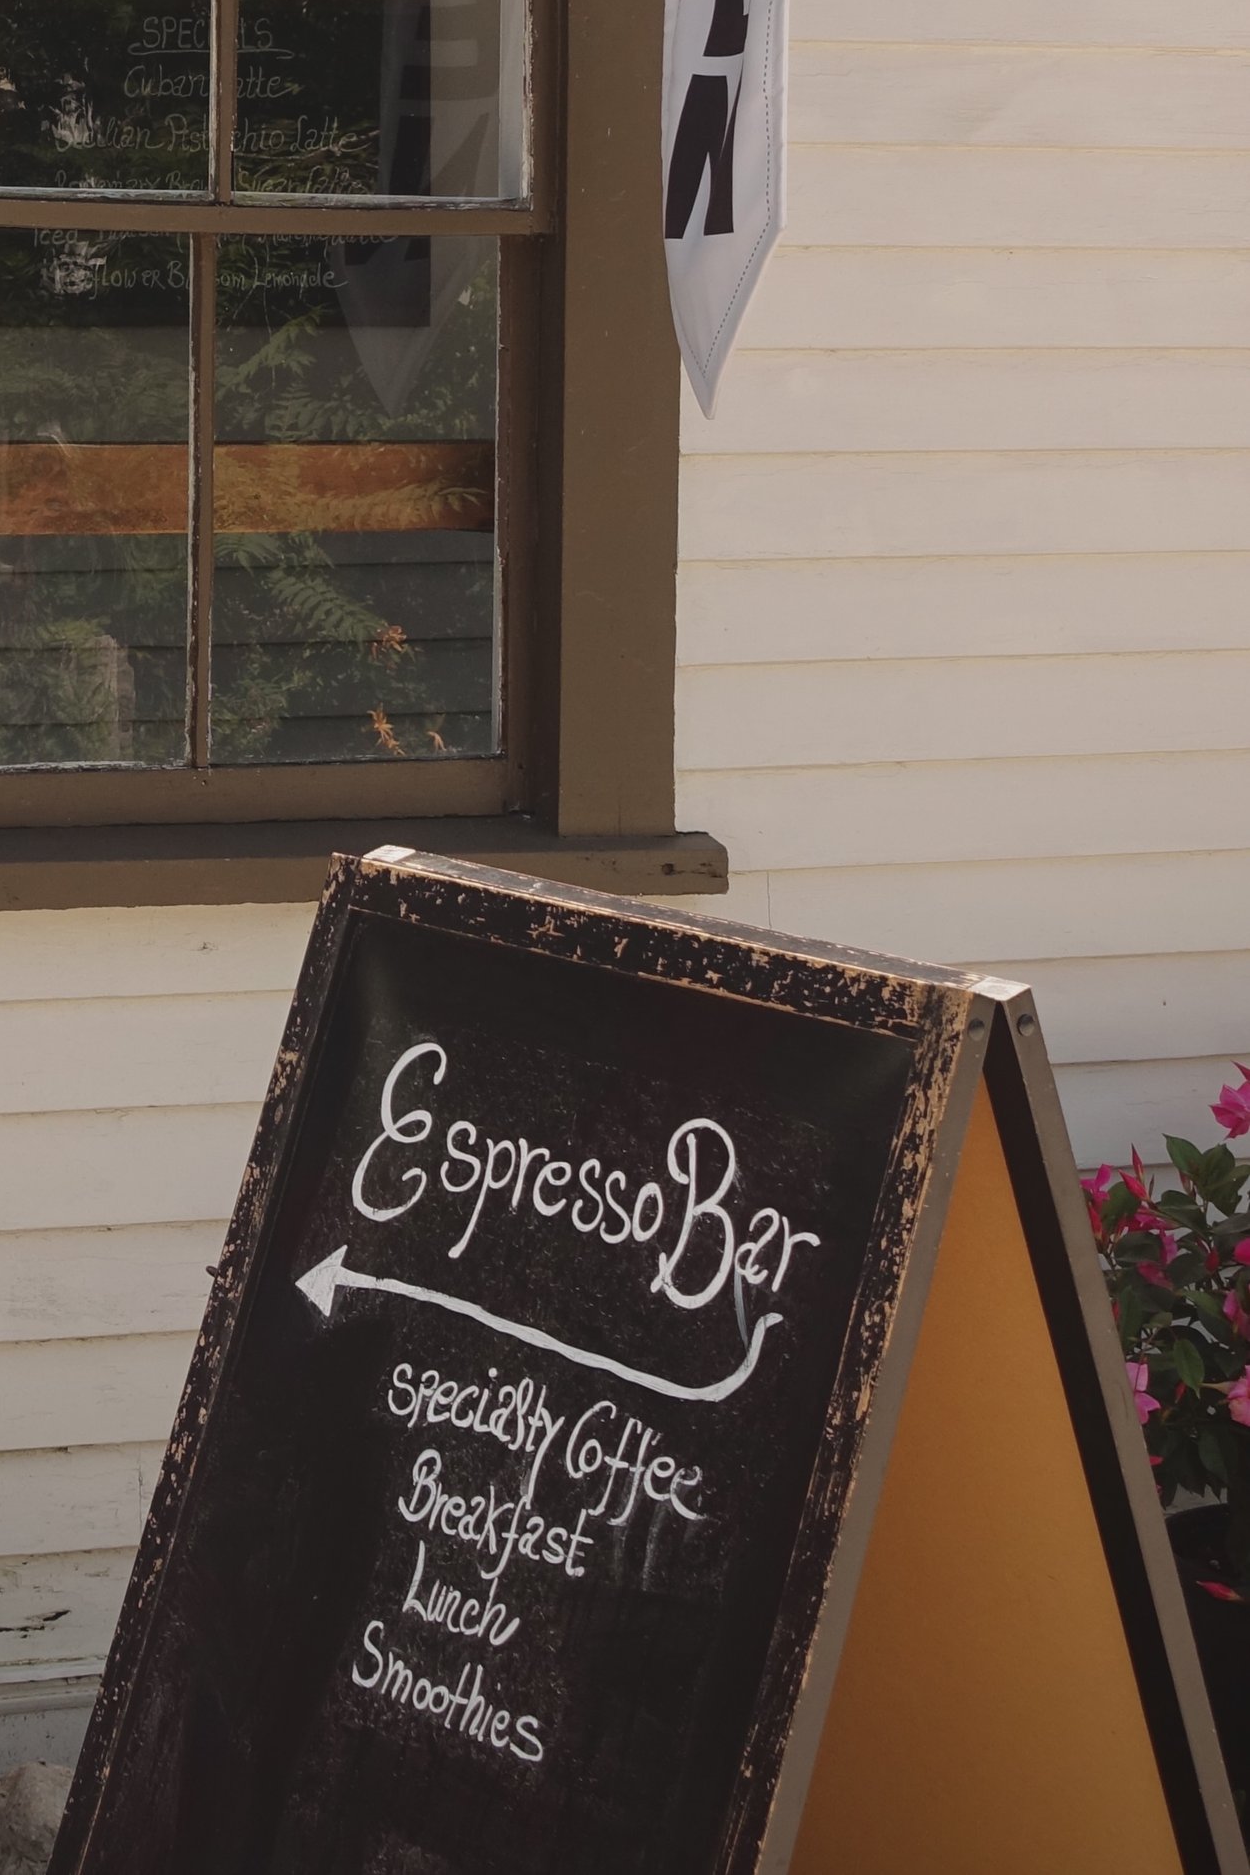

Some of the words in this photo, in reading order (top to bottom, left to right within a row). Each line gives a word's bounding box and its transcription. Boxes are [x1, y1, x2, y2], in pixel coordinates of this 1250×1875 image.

[142, 16, 273, 49] SPECLS
[351, 1042, 664, 1260] Espresso
[651, 1118, 821, 1309] Bar
[399, 1448, 593, 1580] Breakfast
[567, 1399, 706, 1526] Coffee
[402, 1541, 520, 1646] Lunch
[351, 1621, 544, 1762] Smoothies
